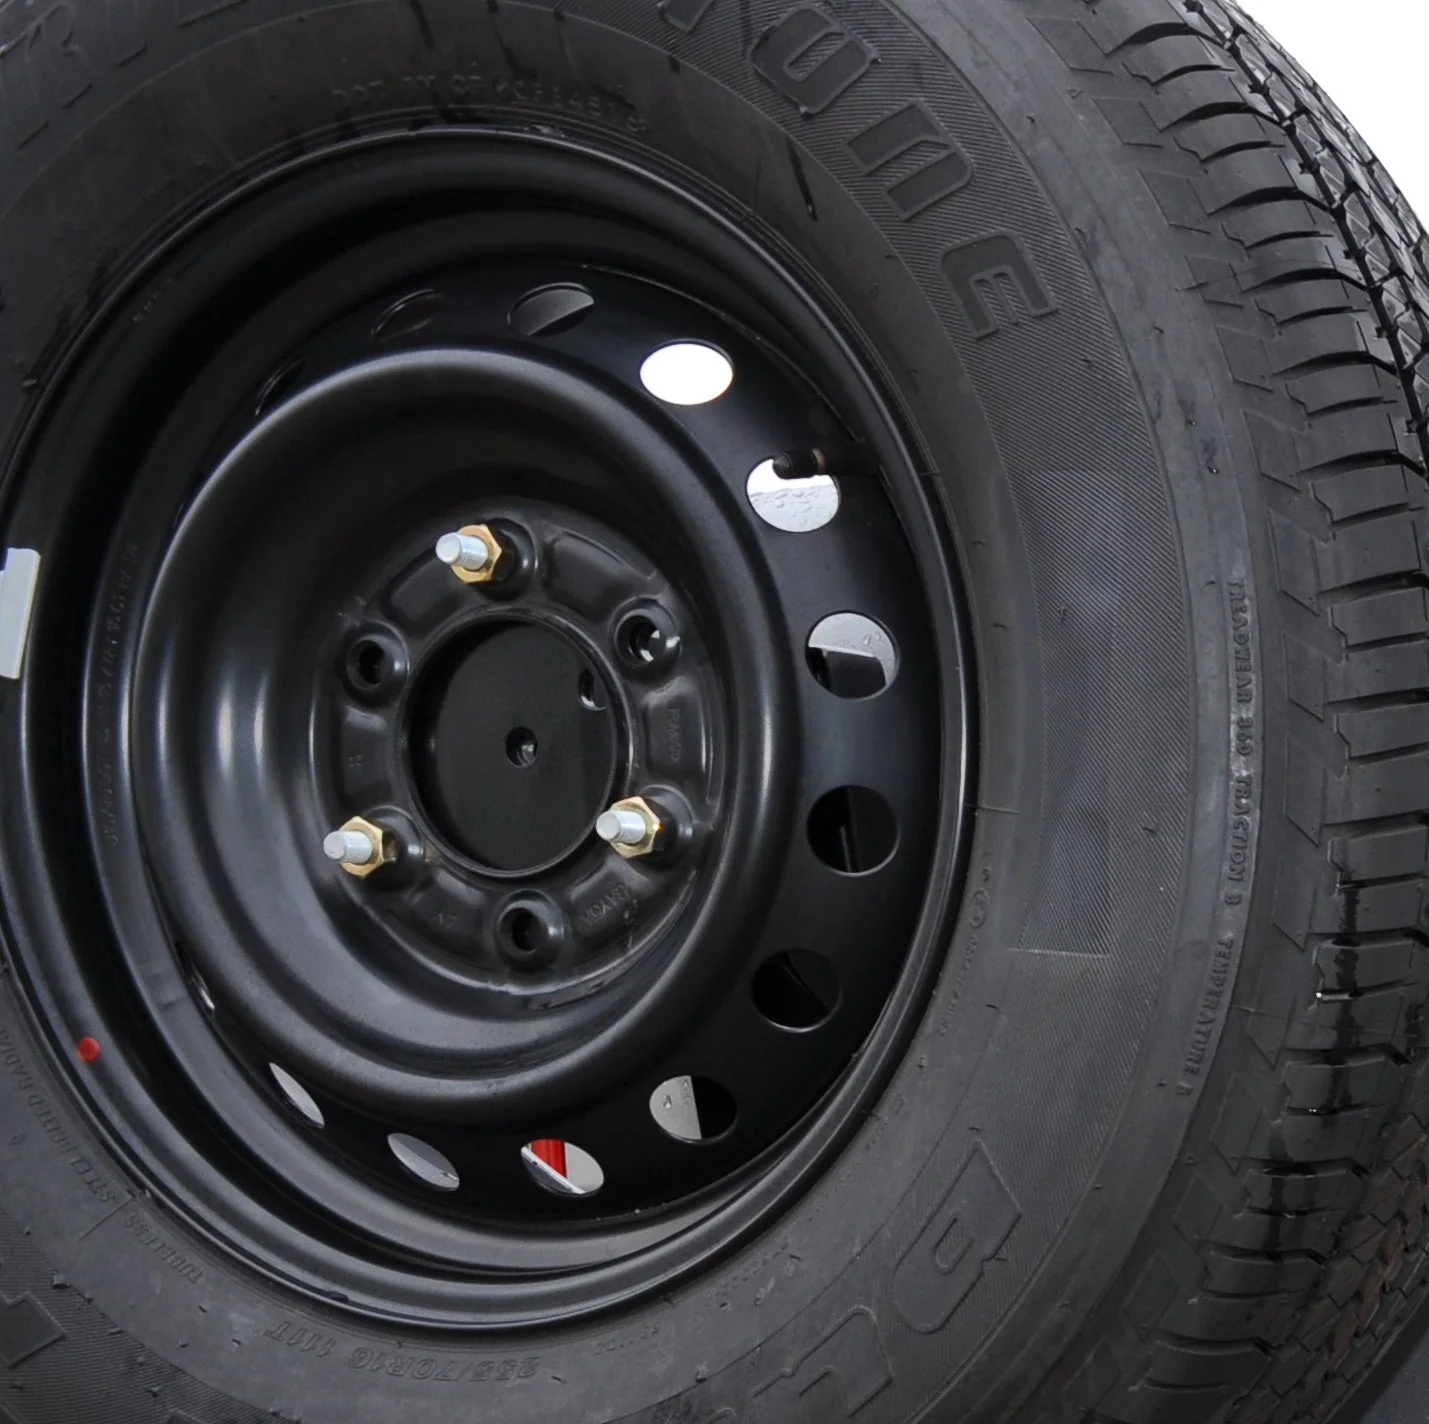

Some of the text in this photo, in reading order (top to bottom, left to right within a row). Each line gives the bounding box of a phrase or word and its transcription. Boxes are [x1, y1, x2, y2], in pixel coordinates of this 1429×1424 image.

[1227, 579, 1254, 704] TREADWEAR
[1228, 774, 1254, 887] TRACTION
[0, 1025, 34, 1091] RADIA
[1182, 937, 1235, 1077] TEMPERATURE
